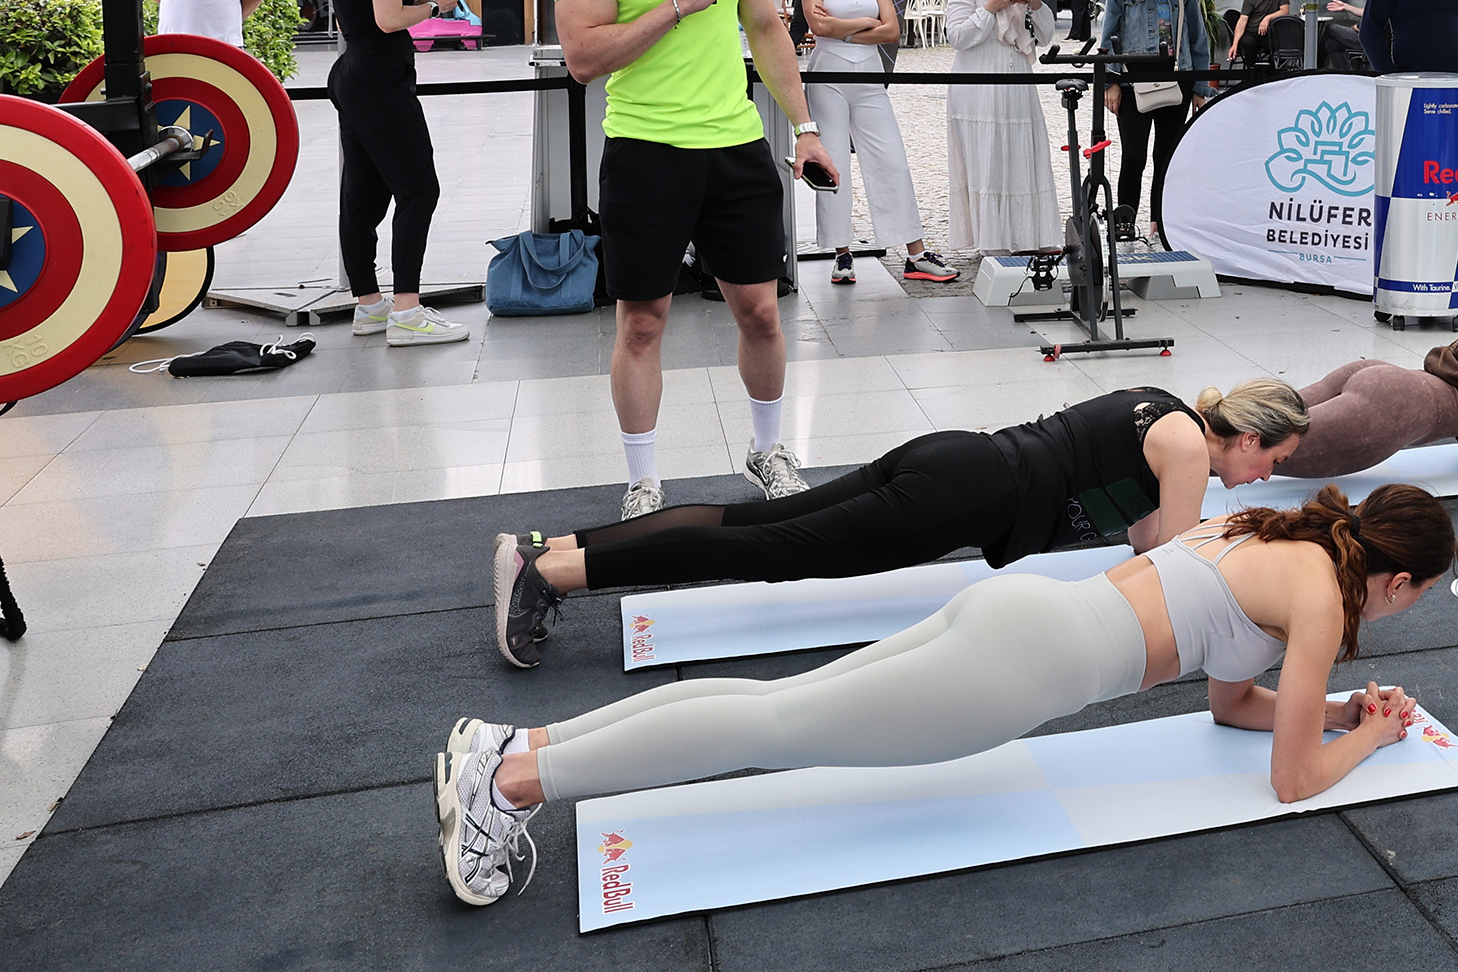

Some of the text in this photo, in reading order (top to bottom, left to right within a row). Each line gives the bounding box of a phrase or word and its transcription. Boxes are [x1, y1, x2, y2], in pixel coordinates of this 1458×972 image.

[1268, 197, 1372, 227] NİLÜFER
[1266, 229, 1369, 250] BELEDİYESİ
[1299, 252, 1333, 264] BURSA
[1412, 283, 1428, 292] With
[2, 343, 31, 370] KG
[25, 332, 49, 359] 10
[1066, 497, 1091, 533] YOUR
[601, 863, 634, 914] Red Bull
